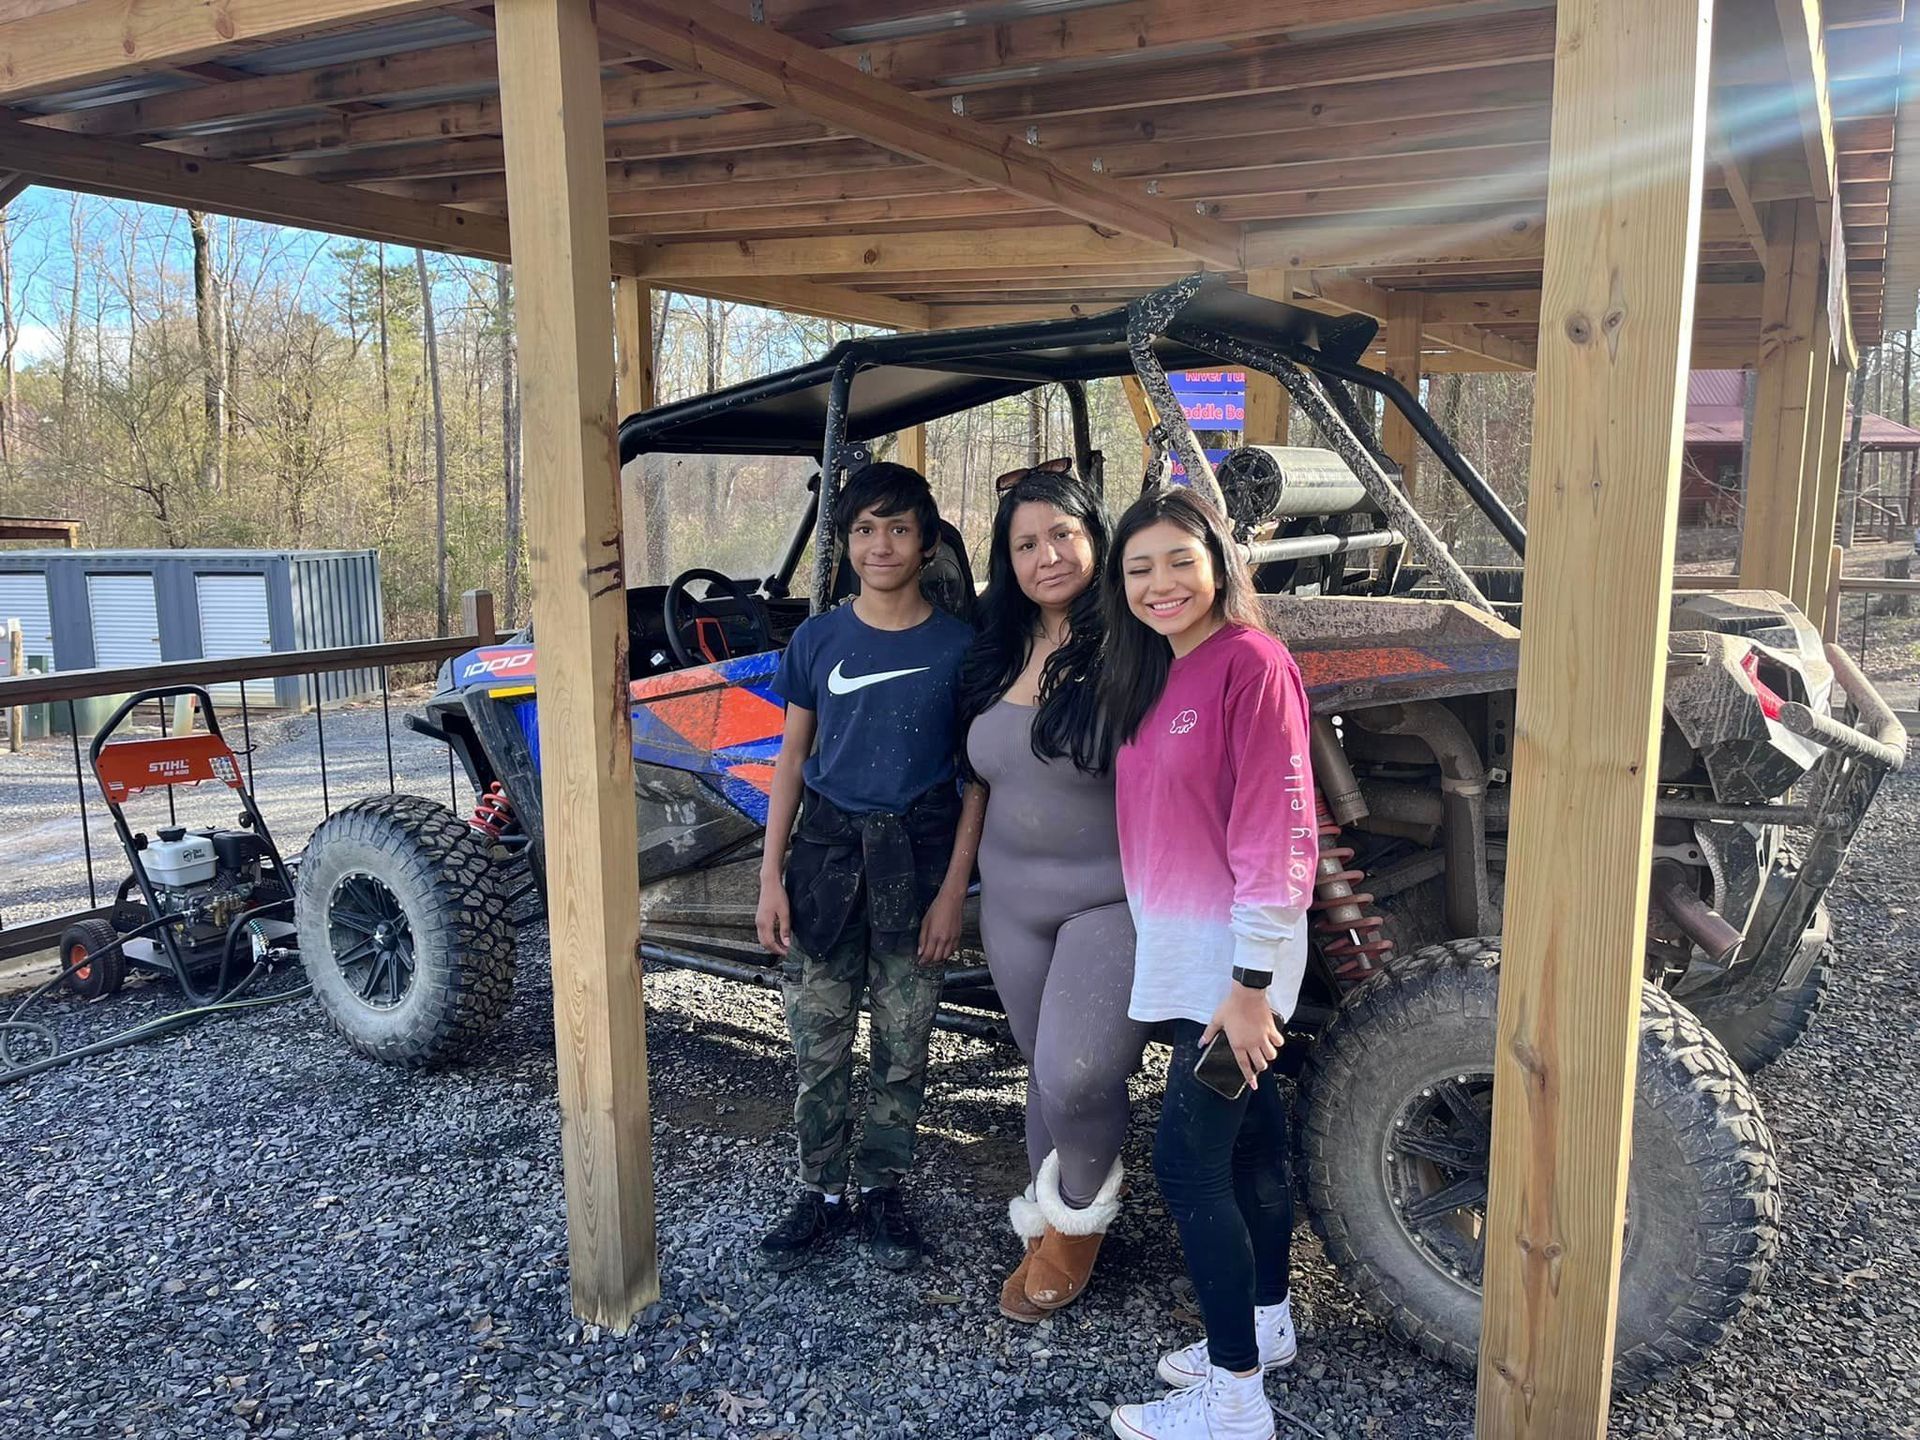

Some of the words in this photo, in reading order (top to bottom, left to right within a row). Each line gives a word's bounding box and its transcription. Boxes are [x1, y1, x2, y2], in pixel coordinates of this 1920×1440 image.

[1180, 403, 1223, 420] addle
[463, 653, 533, 678] 1000
[148, 759, 190, 772] STIHL
[1284, 752, 1307, 811] ella
